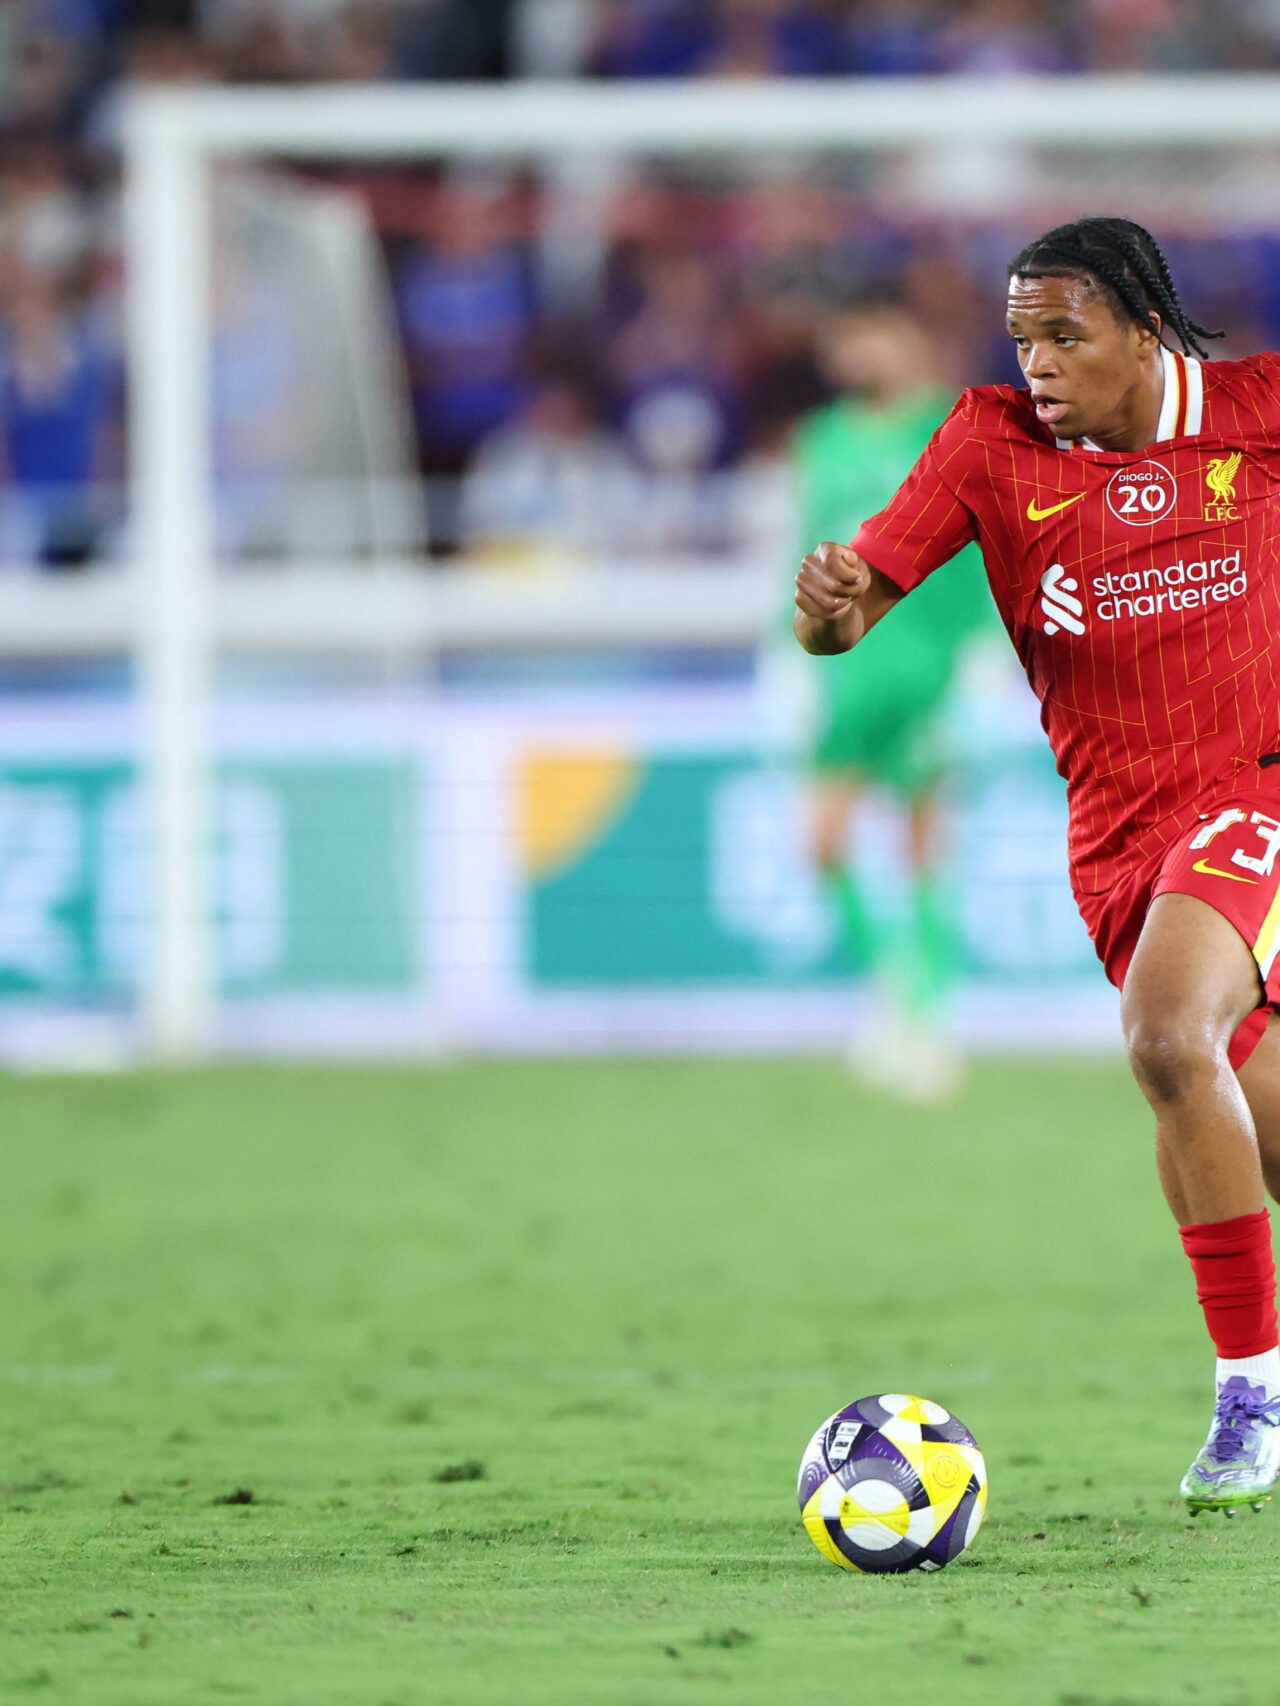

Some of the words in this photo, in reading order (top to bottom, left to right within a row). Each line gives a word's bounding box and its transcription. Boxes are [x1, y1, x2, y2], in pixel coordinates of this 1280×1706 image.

[1118, 472, 1153, 483] DIOGO
[1118, 484, 1166, 513] 20
[1092, 550, 1240, 597] standard
[1096, 571, 1247, 620] chartered
